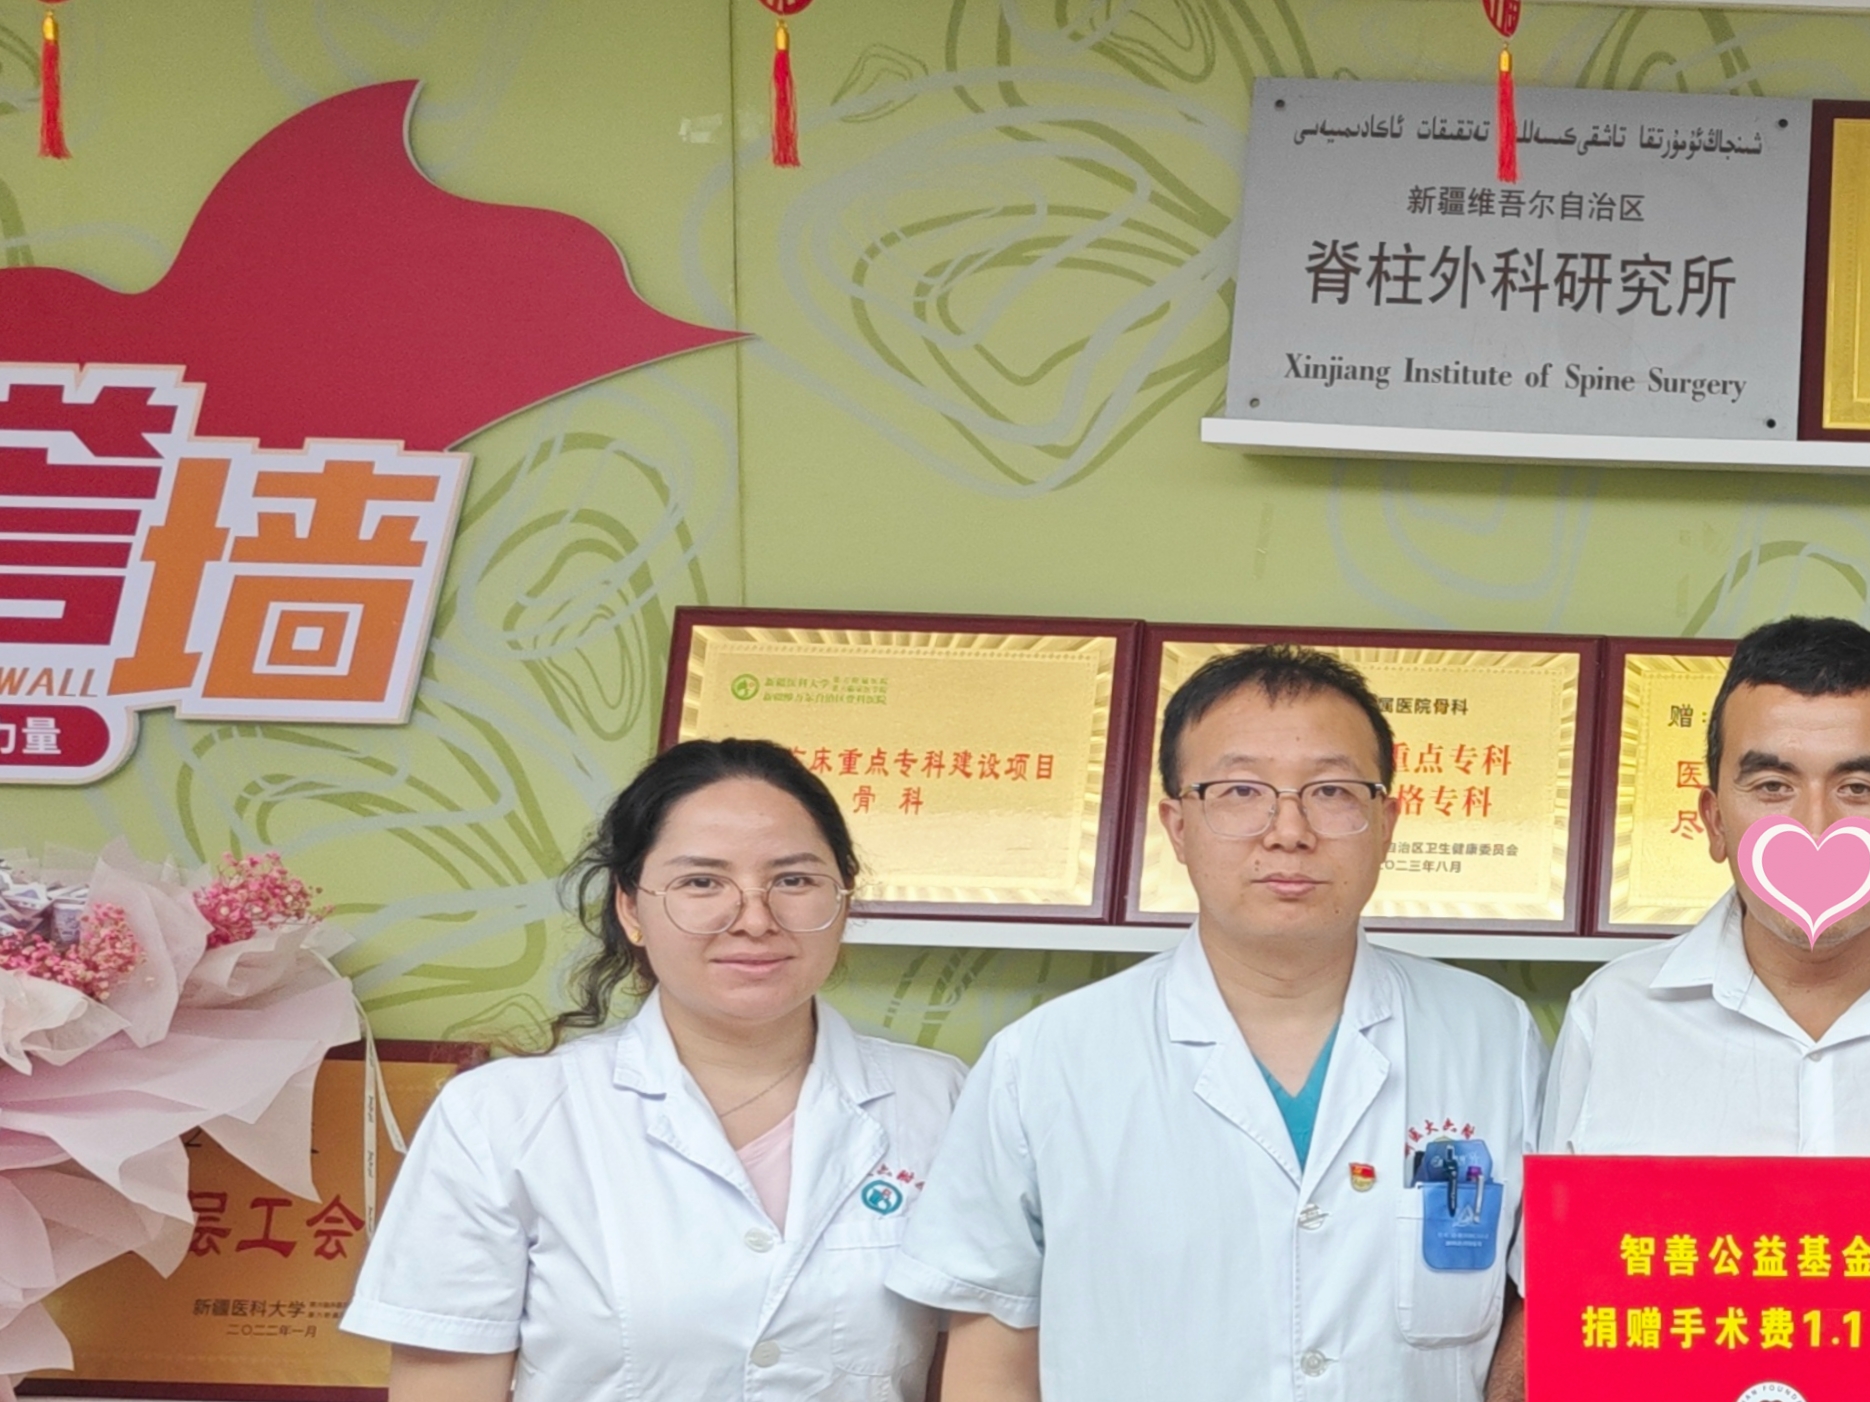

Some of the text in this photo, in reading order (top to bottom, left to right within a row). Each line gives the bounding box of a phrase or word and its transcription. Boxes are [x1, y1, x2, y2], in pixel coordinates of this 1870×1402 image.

[1406, 184, 1646, 222] 新疆维吾尔自治区
[1304, 239, 1738, 319] 脊柱外科研究所
[1283, 353, 1747, 402] Xinjiang Institute of Spine Surgery
[0, 667, 98, 697] WALL
[193, 1299, 304, 1318] 新疆医科大学
